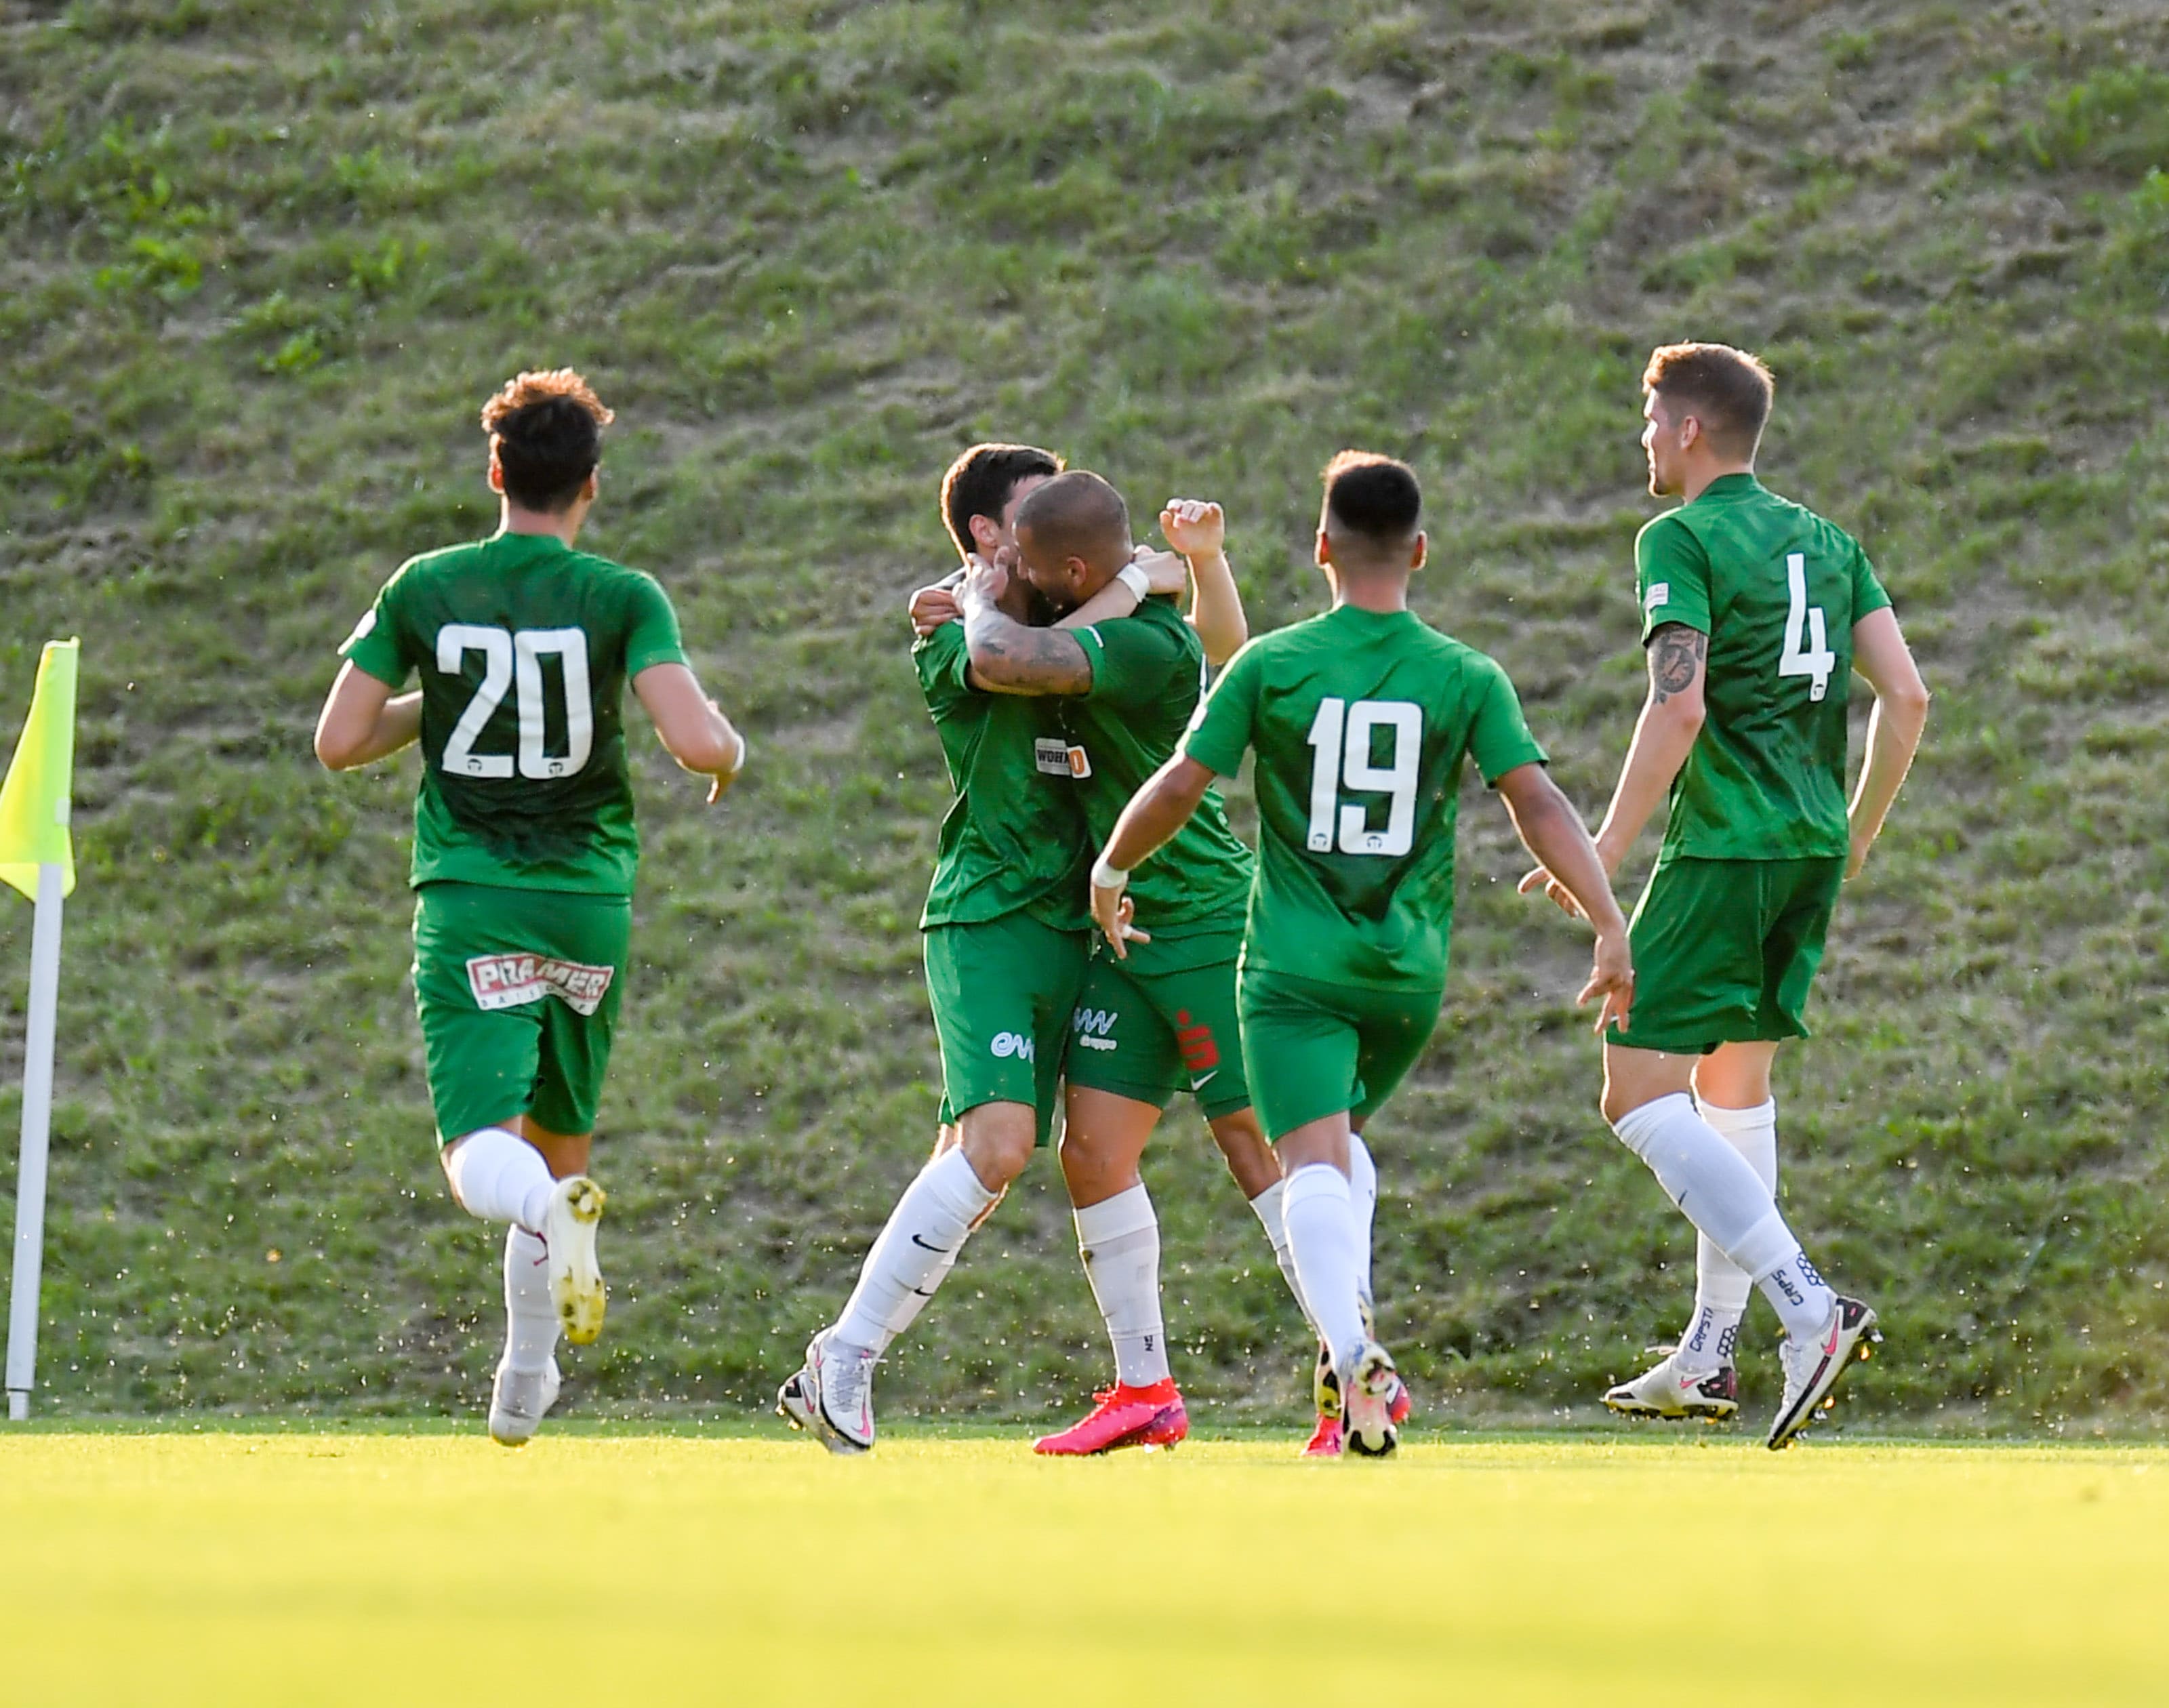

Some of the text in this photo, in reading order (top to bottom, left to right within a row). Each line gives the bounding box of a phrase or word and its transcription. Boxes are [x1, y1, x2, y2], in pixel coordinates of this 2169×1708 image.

[436, 624, 594, 779] 20
[1778, 552, 1836, 702] 4
[1306, 697, 1423, 857] 19
